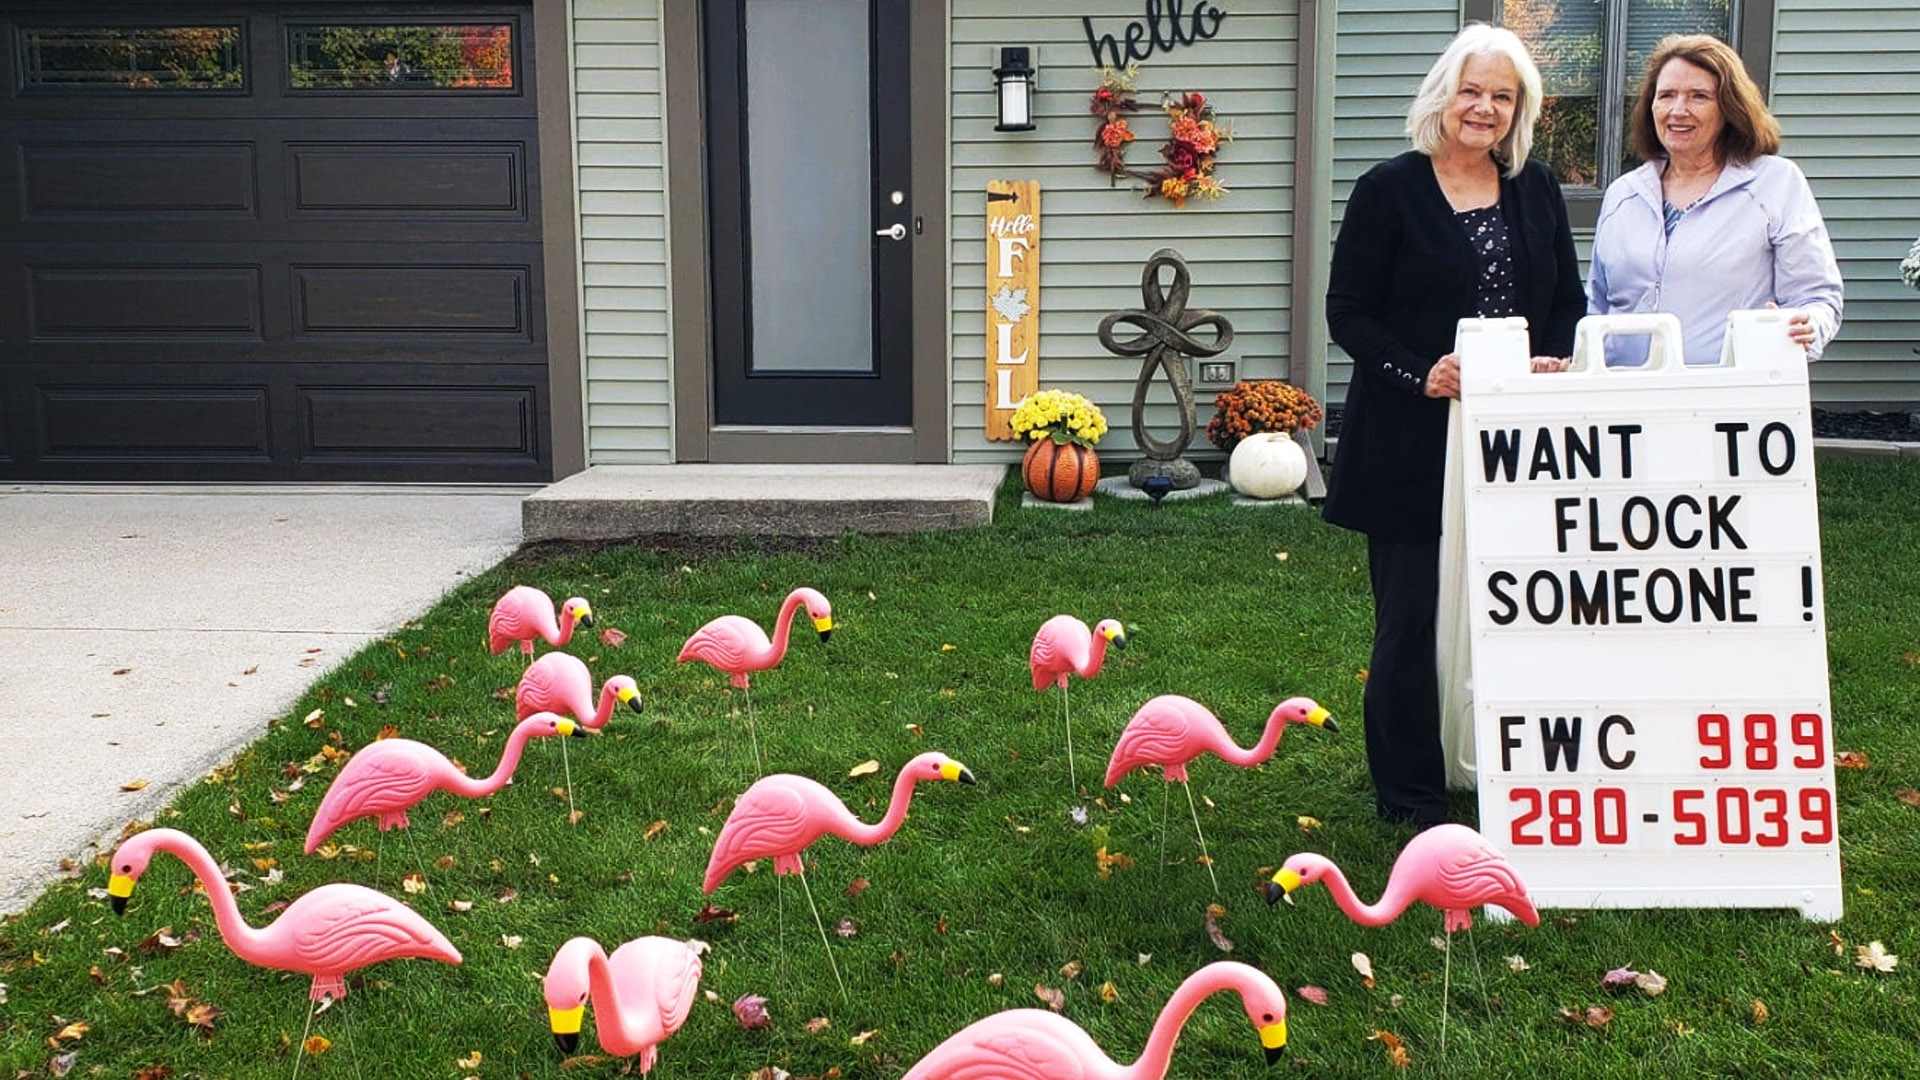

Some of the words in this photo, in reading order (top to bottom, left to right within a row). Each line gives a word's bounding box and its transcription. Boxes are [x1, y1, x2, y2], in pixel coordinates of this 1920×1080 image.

[1082, 0, 1227, 70] hello
[989, 214, 1036, 236] Hello
[1480, 424, 1642, 482] WANT
[1715, 421, 1796, 476] TO
[1555, 494, 1748, 552] FLOCK
[1487, 566, 1758, 625] SOMEONE
[1697, 713, 1825, 769] 989
[1508, 787, 1833, 847] 280-5039
